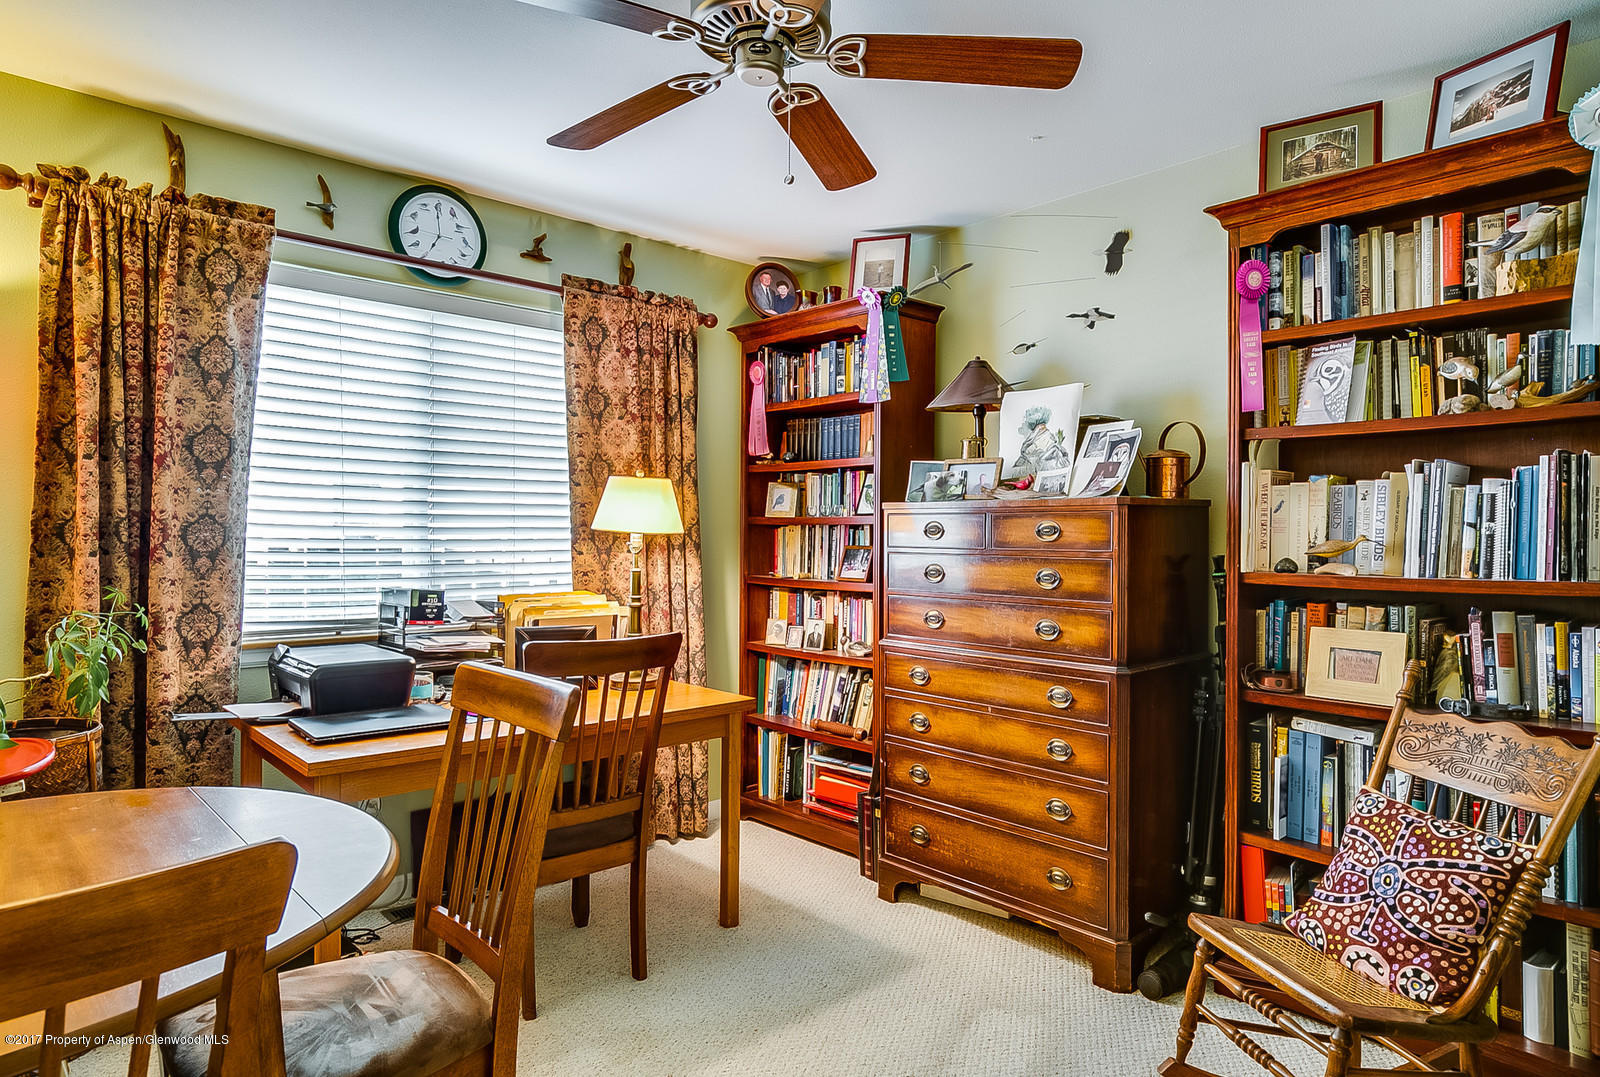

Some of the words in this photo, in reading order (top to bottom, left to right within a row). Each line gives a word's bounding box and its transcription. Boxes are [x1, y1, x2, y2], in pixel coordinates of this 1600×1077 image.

[1260, 483, 1269, 505] WHERE
[1333, 486, 1342, 529] SEABIRDS
[1376, 485, 1387, 526] SIBLEY
[1260, 507, 1268, 519] THE
[1374, 528, 1385, 562] BIRDS
[1251, 770, 1262, 803] BIRDS
